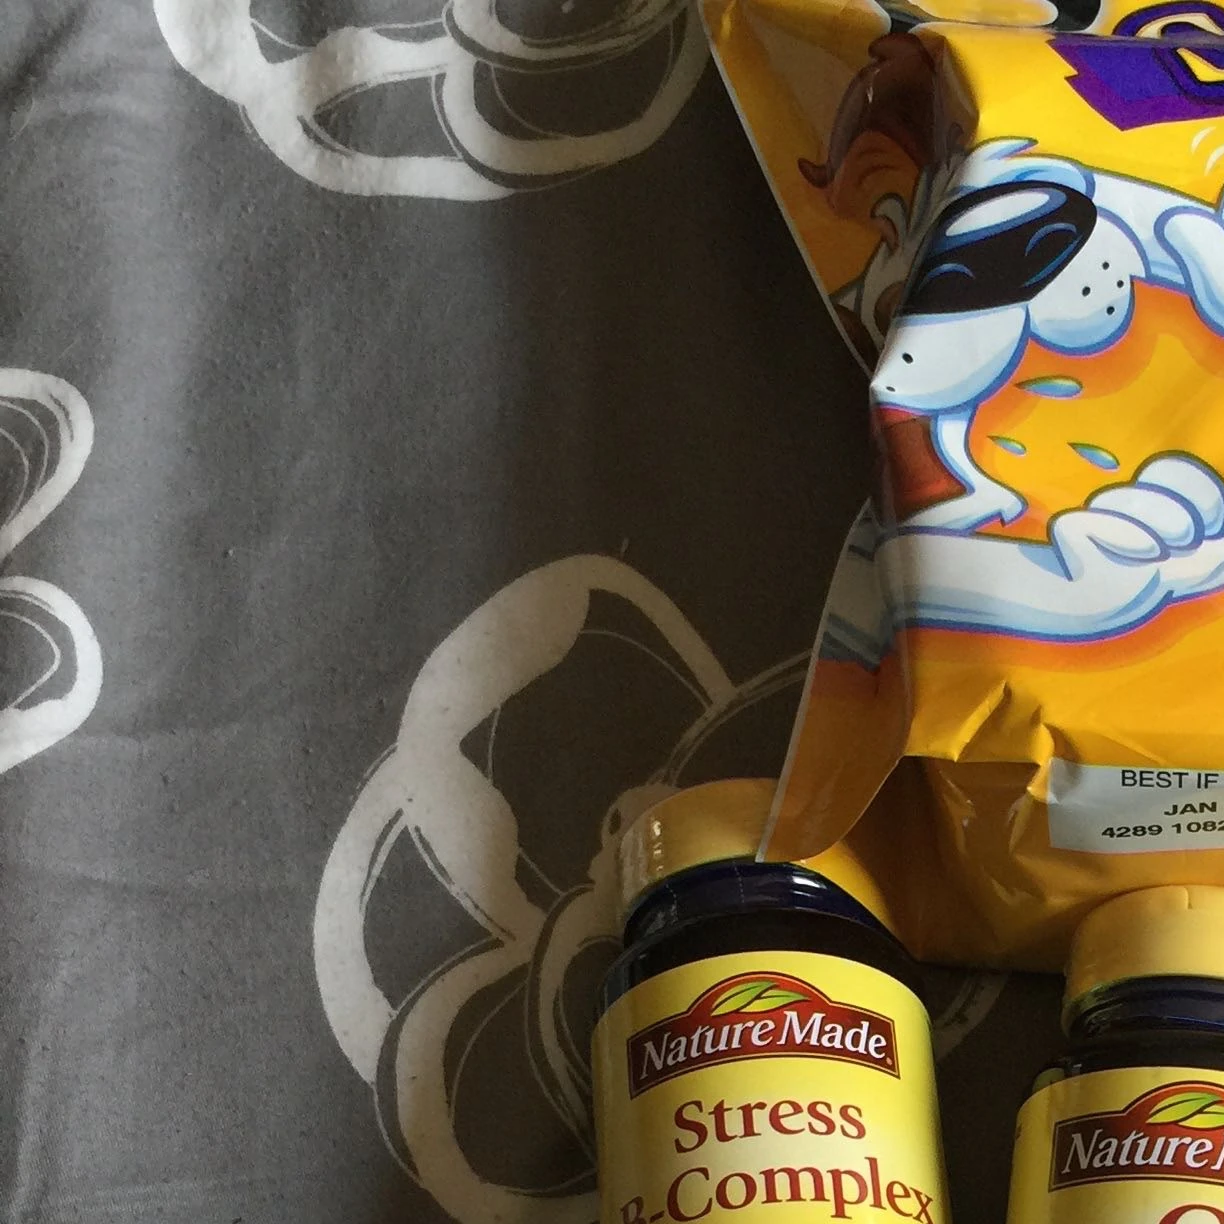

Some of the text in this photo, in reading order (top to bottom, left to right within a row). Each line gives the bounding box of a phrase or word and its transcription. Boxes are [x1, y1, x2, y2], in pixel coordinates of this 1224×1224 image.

[1120, 769, 1189, 791] BEST
[1197, 772, 1219, 791] IF
[1163, 799, 1217, 818] JAN
[1101, 823, 1163, 840] 4289
[673, 1096, 868, 1155] Stress
